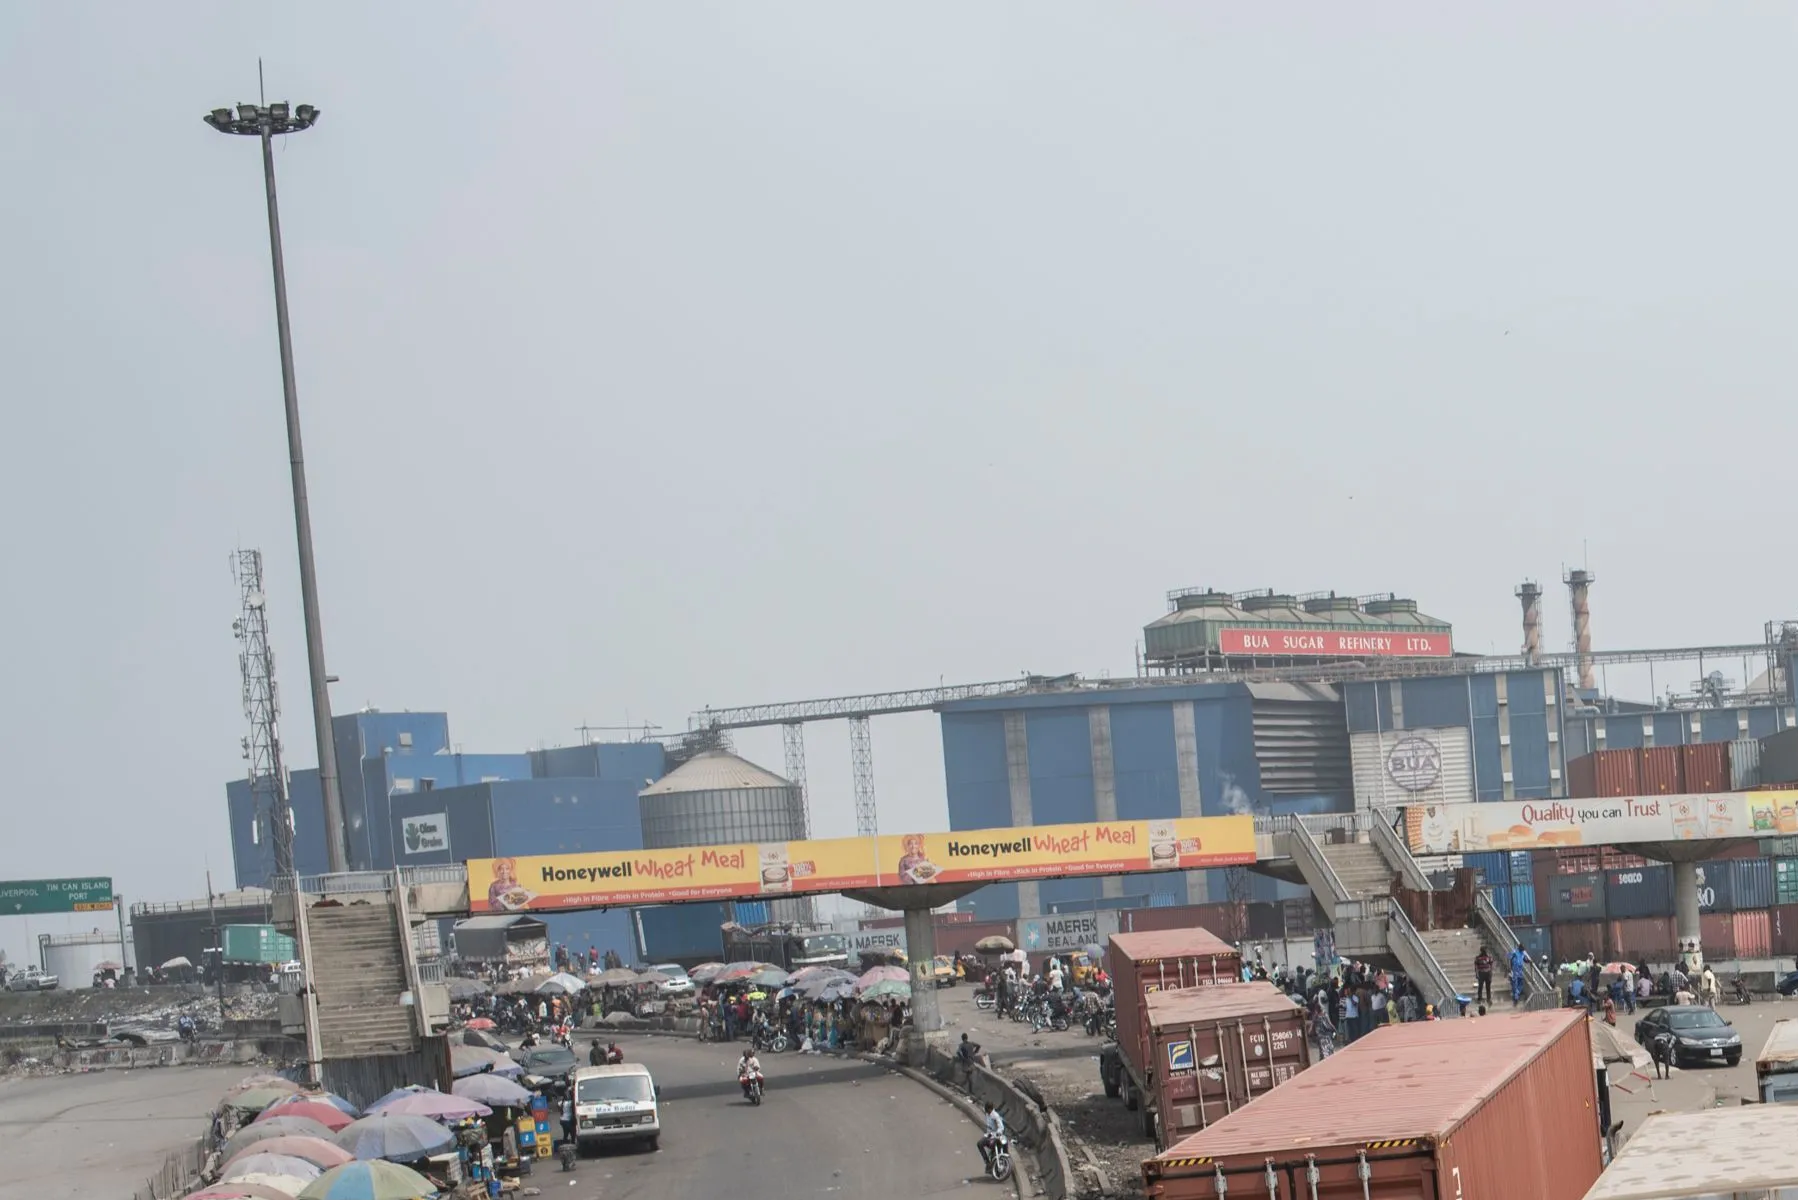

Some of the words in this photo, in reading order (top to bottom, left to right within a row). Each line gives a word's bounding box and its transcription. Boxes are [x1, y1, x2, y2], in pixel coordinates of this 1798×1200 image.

[1244, 635, 1269, 648] BUA
[1283, 636, 1324, 649] SUGAR
[1340, 637, 1392, 650] REFINERY
[1407, 638, 1432, 651] LTD.
[1392, 754, 1437, 771] BUA
[1521, 802, 1575, 825] Quality
[1578, 808, 1599, 823] you
[1602, 809, 1622, 819] can
[1624, 799, 1662, 817] Trust
[948, 837, 1031, 857] Honeywell
[1034, 830, 1090, 855] Wheat
[1096, 826, 1136, 845] Meal
[542, 861, 632, 882] Honeywell
[634, 853, 695, 880] Wheat
[701, 849, 744, 868] Meal
[46, 883, 59, 891] TIN
[62, 882, 78, 891] CAN
[81, 881, 109, 890] ISLAND
[1618, 872, 1643, 885] seaco
[69, 893, 88, 901] PORT
[702, 887, 733, 896] Everyone
[1047, 918, 1098, 935] MAERSK
[856, 934, 900, 949] MAERSK
